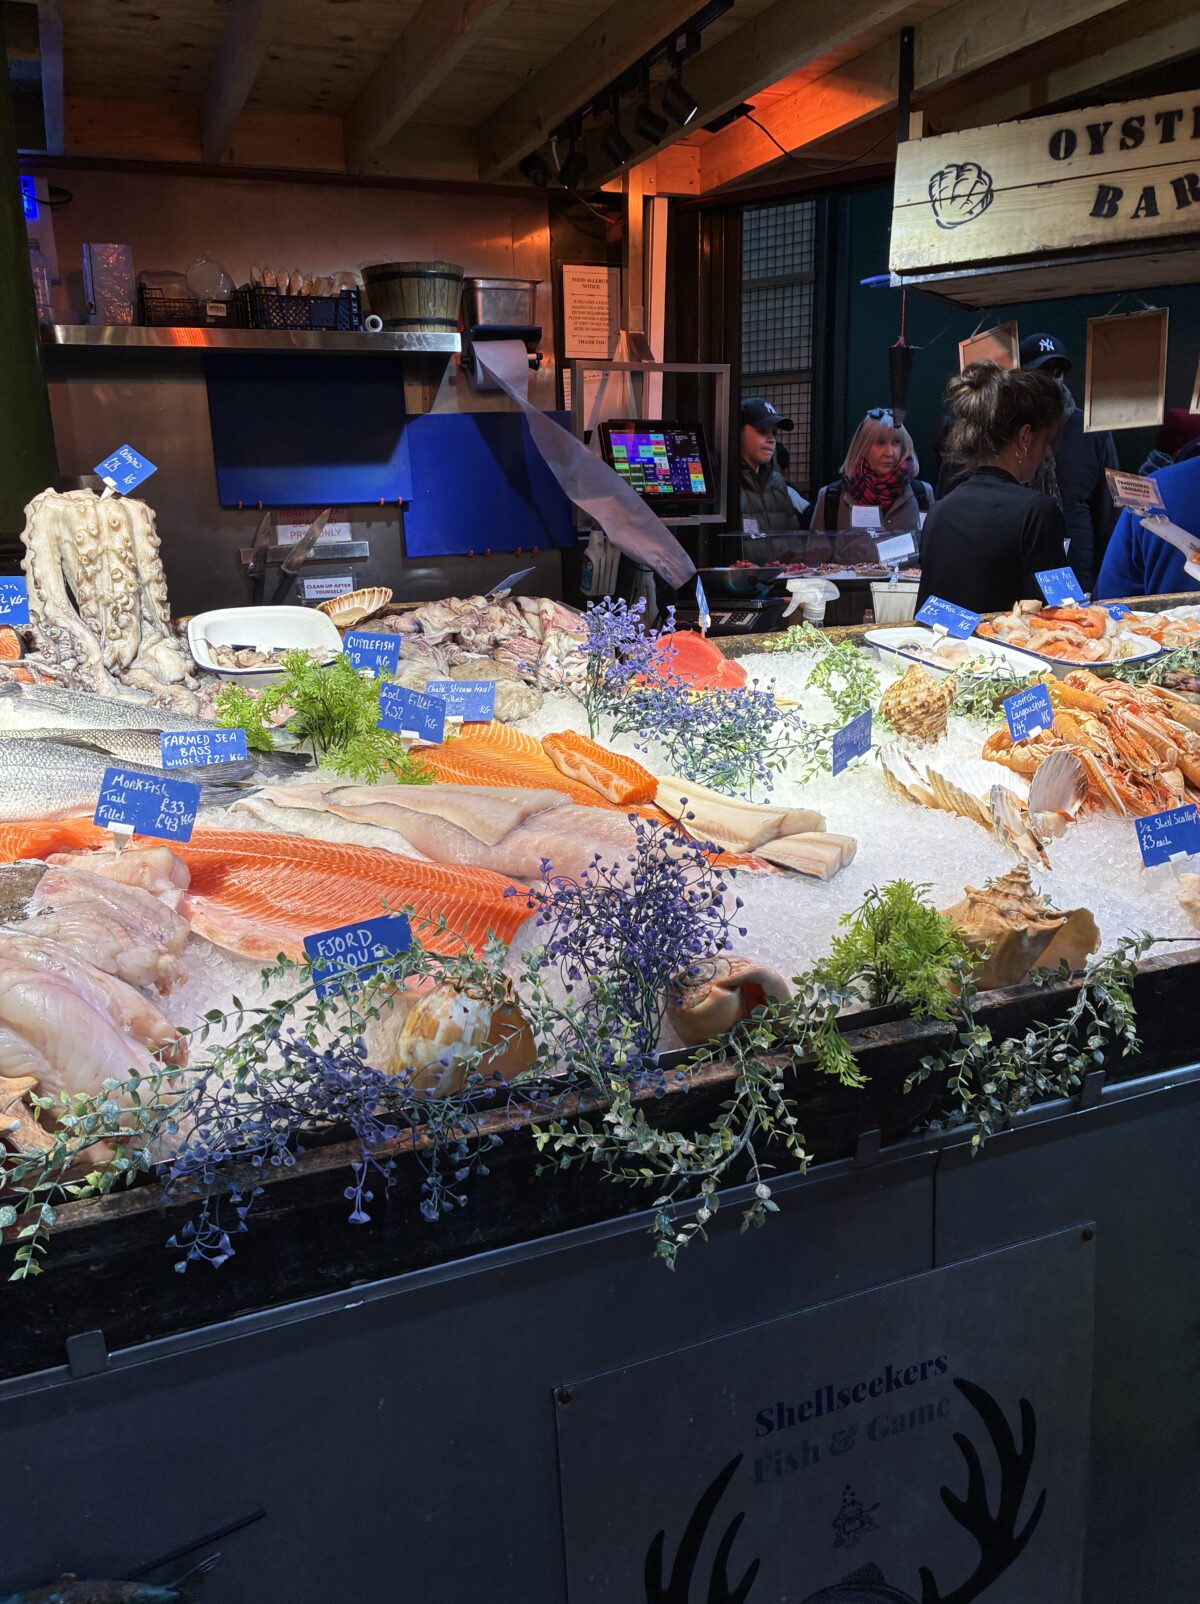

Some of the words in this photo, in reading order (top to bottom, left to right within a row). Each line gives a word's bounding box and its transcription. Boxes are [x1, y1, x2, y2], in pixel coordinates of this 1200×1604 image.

[1089, 173, 1200, 219] BAR
[921, 605, 940, 616] £25
[957, 619, 972, 631] KG
[347, 636, 395, 651] CUTTLEFISH
[479, 704, 492, 714] KG
[424, 714, 439, 729] KG
[163, 734, 210, 748] FARMED
[215, 732, 238, 744] SEA
[180, 745, 212, 757] BASS
[102, 788, 127, 804] Tail
[160, 796, 185, 815] £33
[98, 804, 126, 822] Fillet
[154, 813, 178, 832] £43
[1139, 820, 1152, 834] 1/2
[1154, 814, 1173, 830] Shell
[1142, 834, 1155, 851] £3
[1156, 835, 1173, 848] each
[316, 929, 373, 957] FJORD
[755, 1354, 949, 1438] Shellseekers
[753, 1439, 821, 1486] Fish
[829, 1423, 860, 1456] &
[866, 1397, 952, 1443] Game
